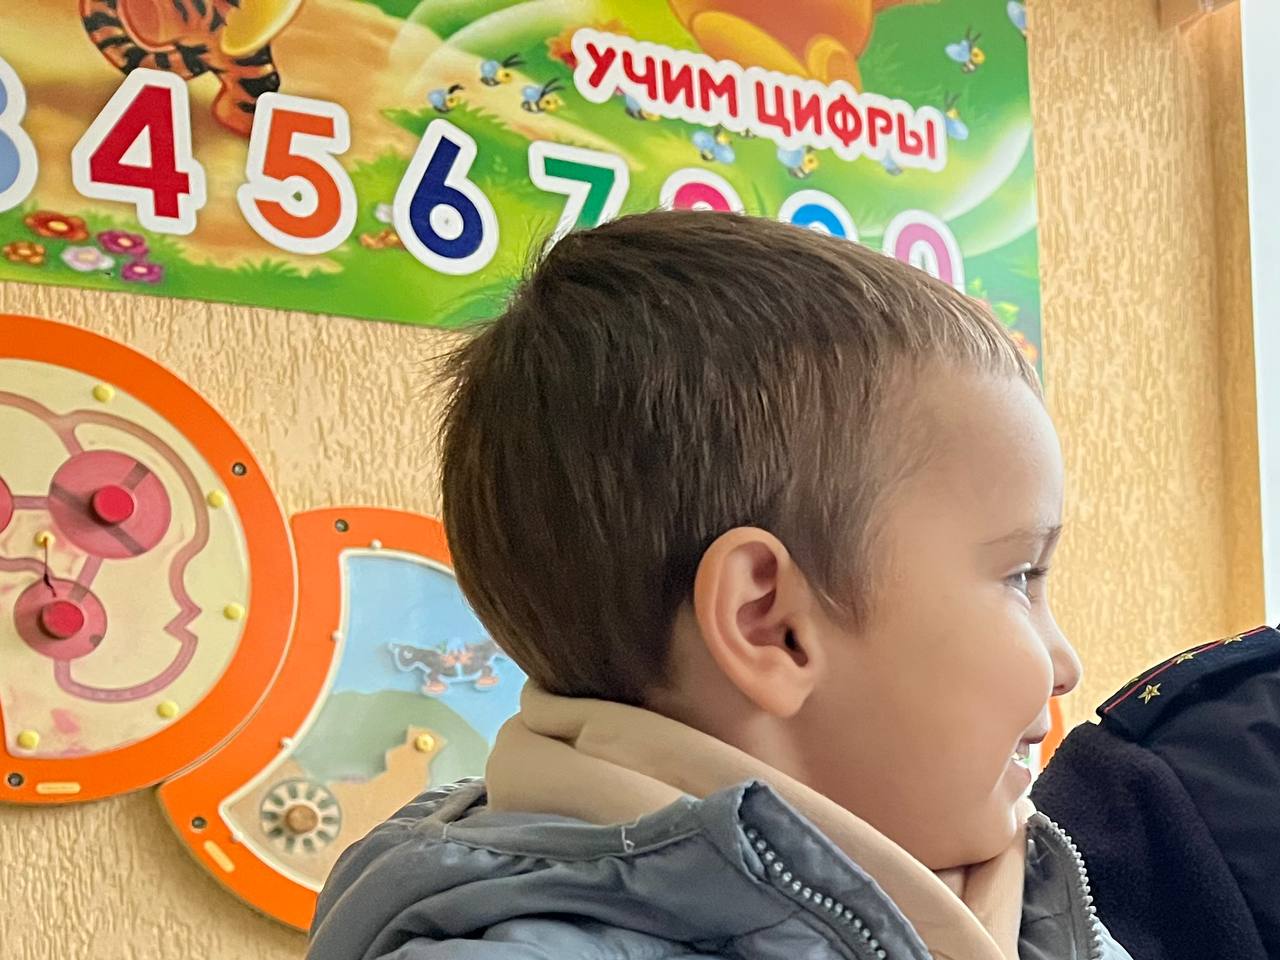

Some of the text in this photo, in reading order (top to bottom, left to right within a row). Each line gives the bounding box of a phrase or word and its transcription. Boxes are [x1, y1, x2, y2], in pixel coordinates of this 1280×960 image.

[90, 85, 190, 219] 4
[255, 109, 341, 238] 5
[409, 136, 483, 259] 6
[543, 156, 615, 230] 7
[585, 42, 936, 160] УЧИМ ЦИФРЫ
